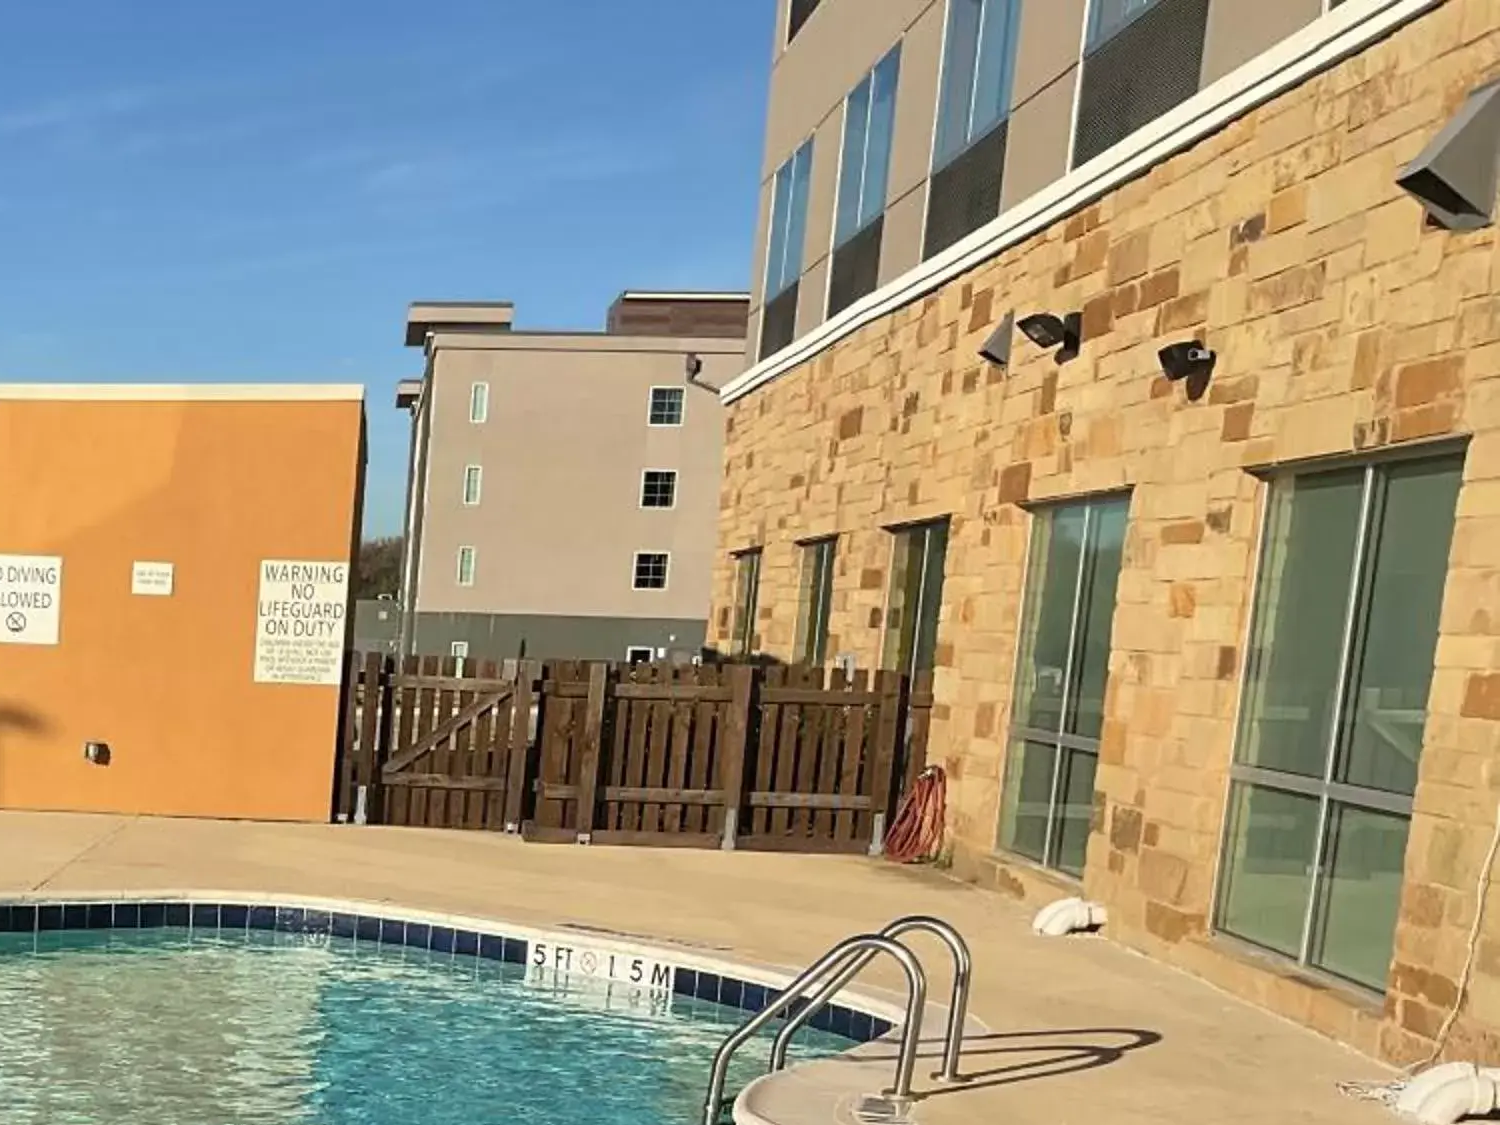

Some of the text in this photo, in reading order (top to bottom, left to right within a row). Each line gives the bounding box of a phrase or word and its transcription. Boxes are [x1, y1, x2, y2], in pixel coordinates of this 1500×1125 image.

[7, 565, 57, 585] DIVING
[264, 564, 344, 583] WARNING
[291, 583, 315, 600] NO
[259, 600, 344, 619] LIFEGUARD
[265, 619, 336, 637] ON DUTY
[533, 943, 547, 966] 5
[555, 946, 574, 970] FT
[651, 963, 671, 989] M
